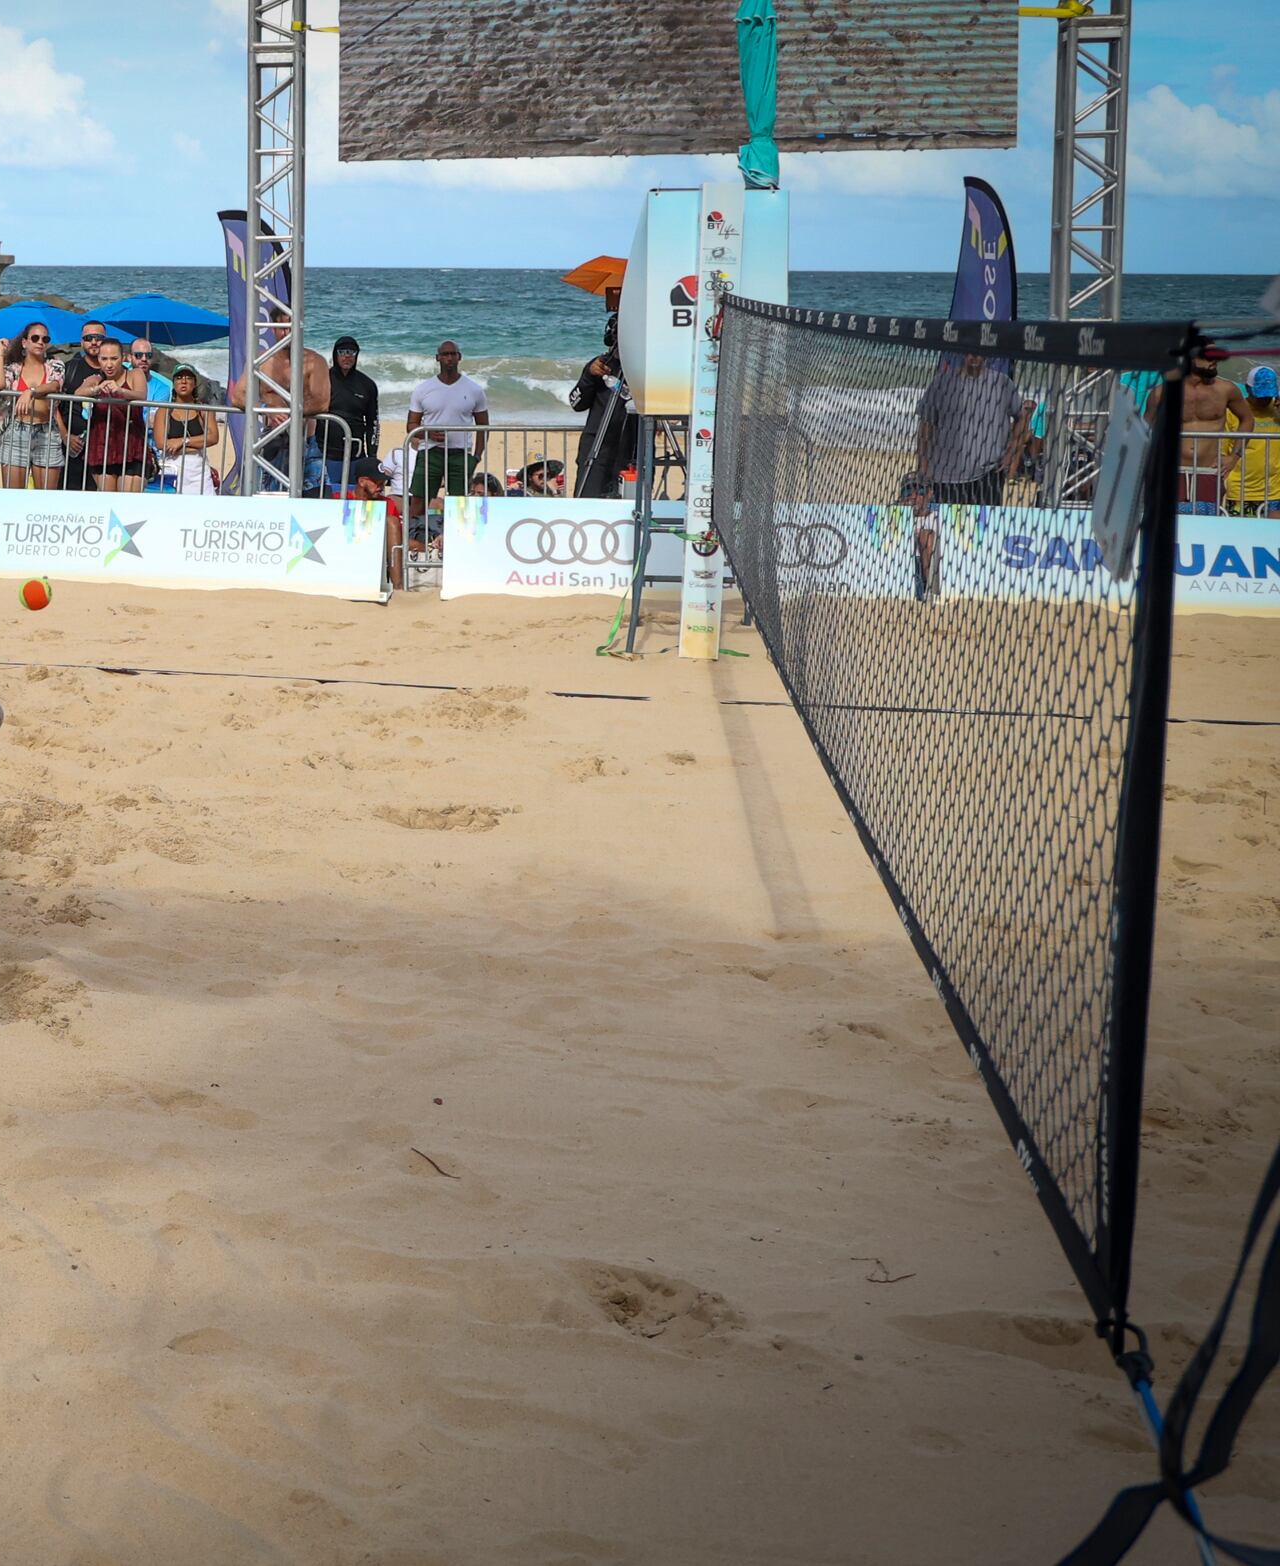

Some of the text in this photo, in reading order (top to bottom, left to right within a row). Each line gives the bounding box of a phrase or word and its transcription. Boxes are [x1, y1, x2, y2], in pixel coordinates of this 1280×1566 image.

[707, 222, 721, 230] BT
[672, 308, 693, 328] B
[26, 512, 105, 525] COMPAÑÍA DE
[203, 519, 285, 531] COMPAÑÍA DE
[3, 522, 103, 545] TURISMO
[180, 528, 284, 552] TURISMO
[7, 544, 101, 558] PUERTO RICO
[185, 550, 282, 565] PUERTO RICO
[1175, 543, 1280, 580] UAN
[506, 570, 564, 586] Audi
[569, 572, 603, 587] San
